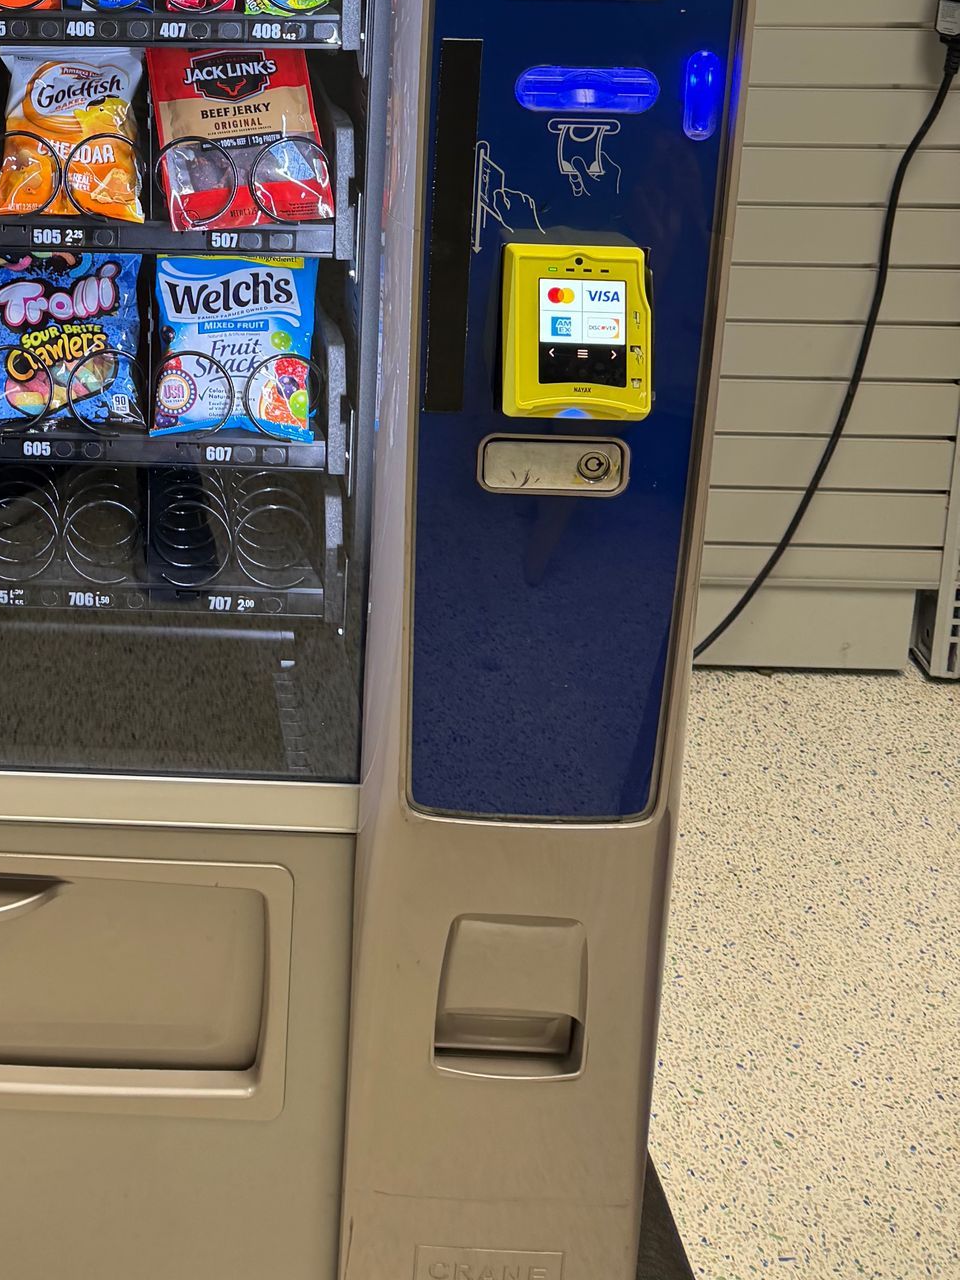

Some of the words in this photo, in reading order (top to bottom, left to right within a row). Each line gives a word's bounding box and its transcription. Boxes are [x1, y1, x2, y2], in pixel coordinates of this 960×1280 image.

[67, 21, 94, 36] 406
[160, 23, 186, 37] 407
[252, 23, 281, 38] 408
[185, 65, 226, 83] JACK
[226, 60, 277, 77] LINK'S
[37, 75, 123, 108] Goldfish
[201, 108, 230, 119] BEEF
[232, 103, 271, 116] JERKY
[214, 117, 263, 131] ORIGINAL
[37, 138, 115, 164] CHEDDAR
[33, 229, 61, 243] 505
[212, 233, 238, 247] 507
[165, 273, 294, 314] Welch's
[586, 290, 620, 302] VISA
[220, 311, 245, 319] FARMER
[204, 321, 234, 330] MIXED
[237, 321, 264, 329] FRUIT
[22, 326, 60, 348] SOUR
[63, 324, 102, 334] BRITE
[211, 338, 263, 357] Fruit
[7, 333, 108, 380] Crawlers
[115, 396, 126, 404] 90
[23, 442, 50, 455] 605
[206, 447, 232, 461] 607
[69, 592, 93, 606] 706
[209, 597, 232, 611] 707
[428, 1262, 547, 1280] CRANE
